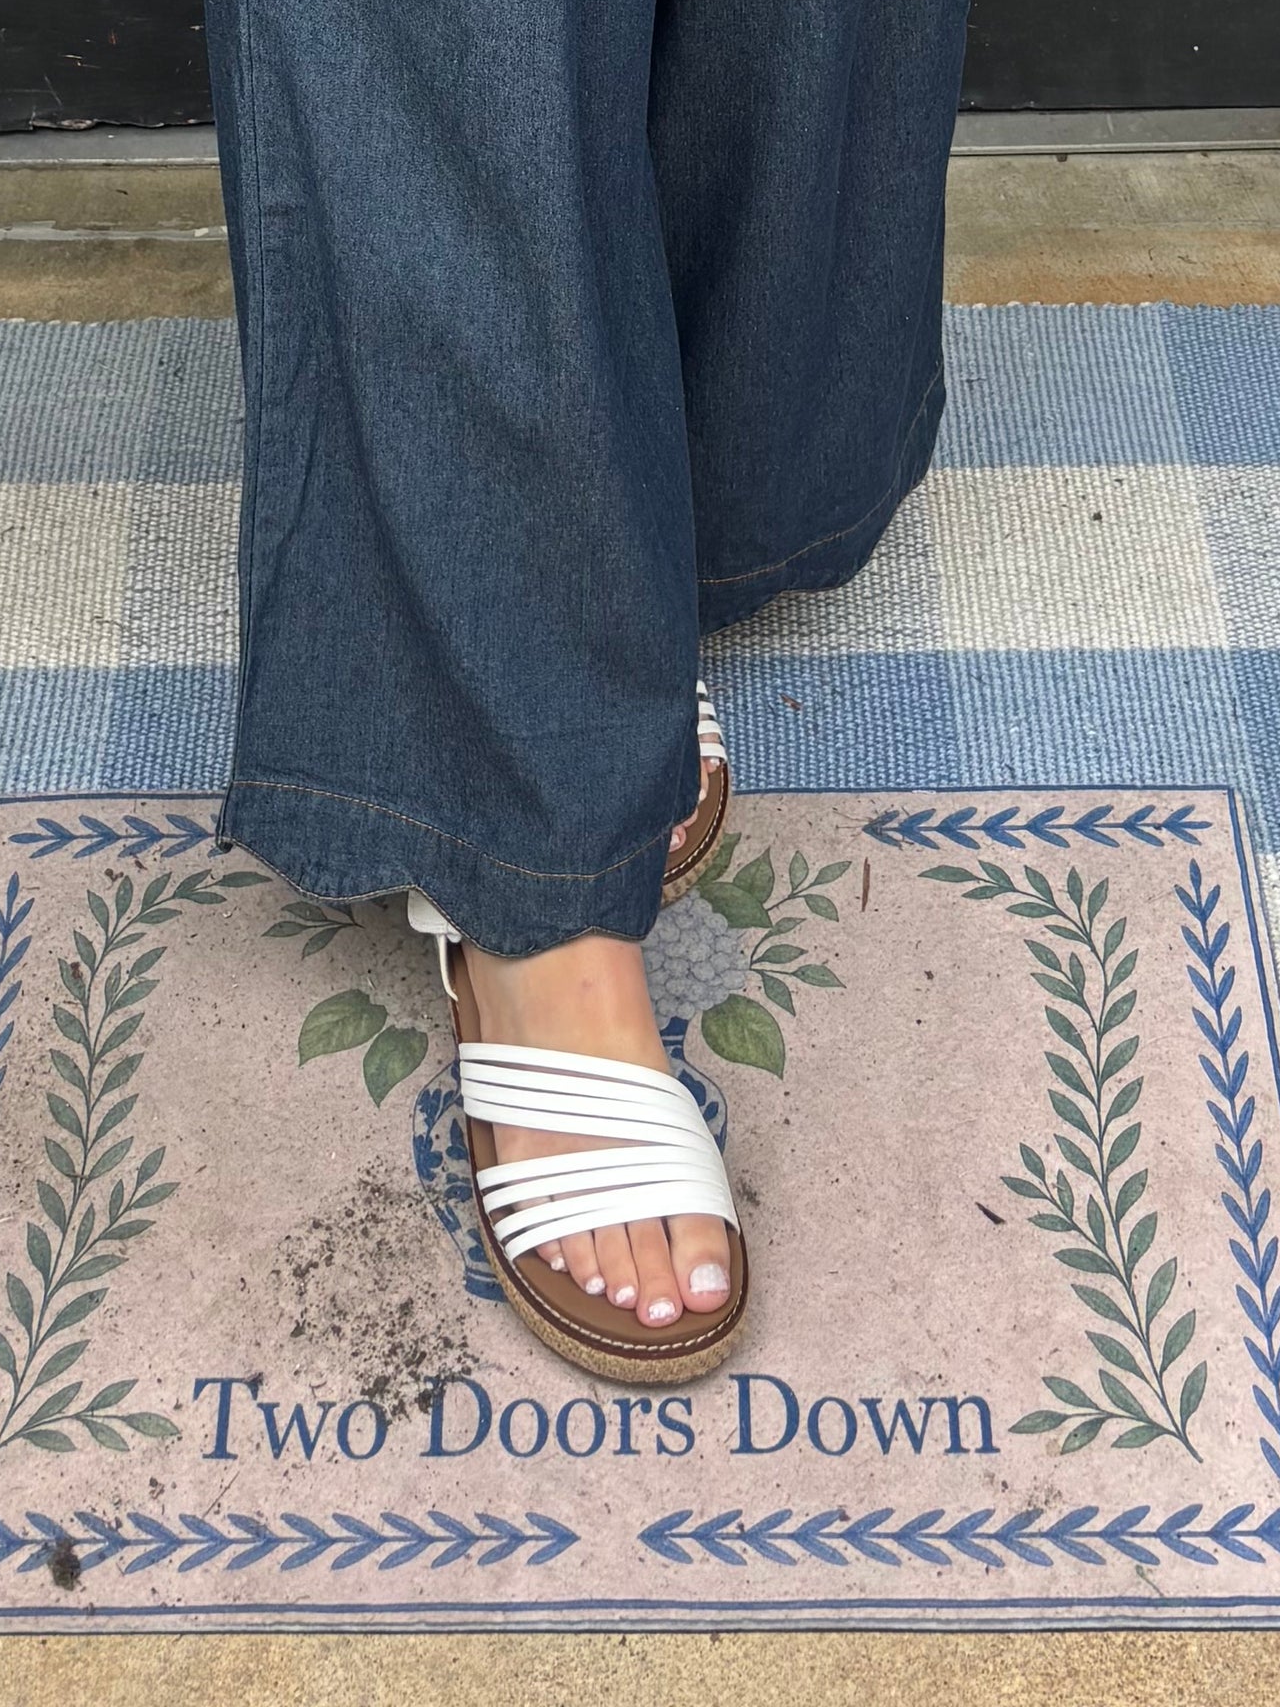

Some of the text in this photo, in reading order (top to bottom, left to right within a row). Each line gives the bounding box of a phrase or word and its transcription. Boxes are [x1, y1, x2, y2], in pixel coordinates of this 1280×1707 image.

[193, 1372, 1002, 1461] Two Doors Down
